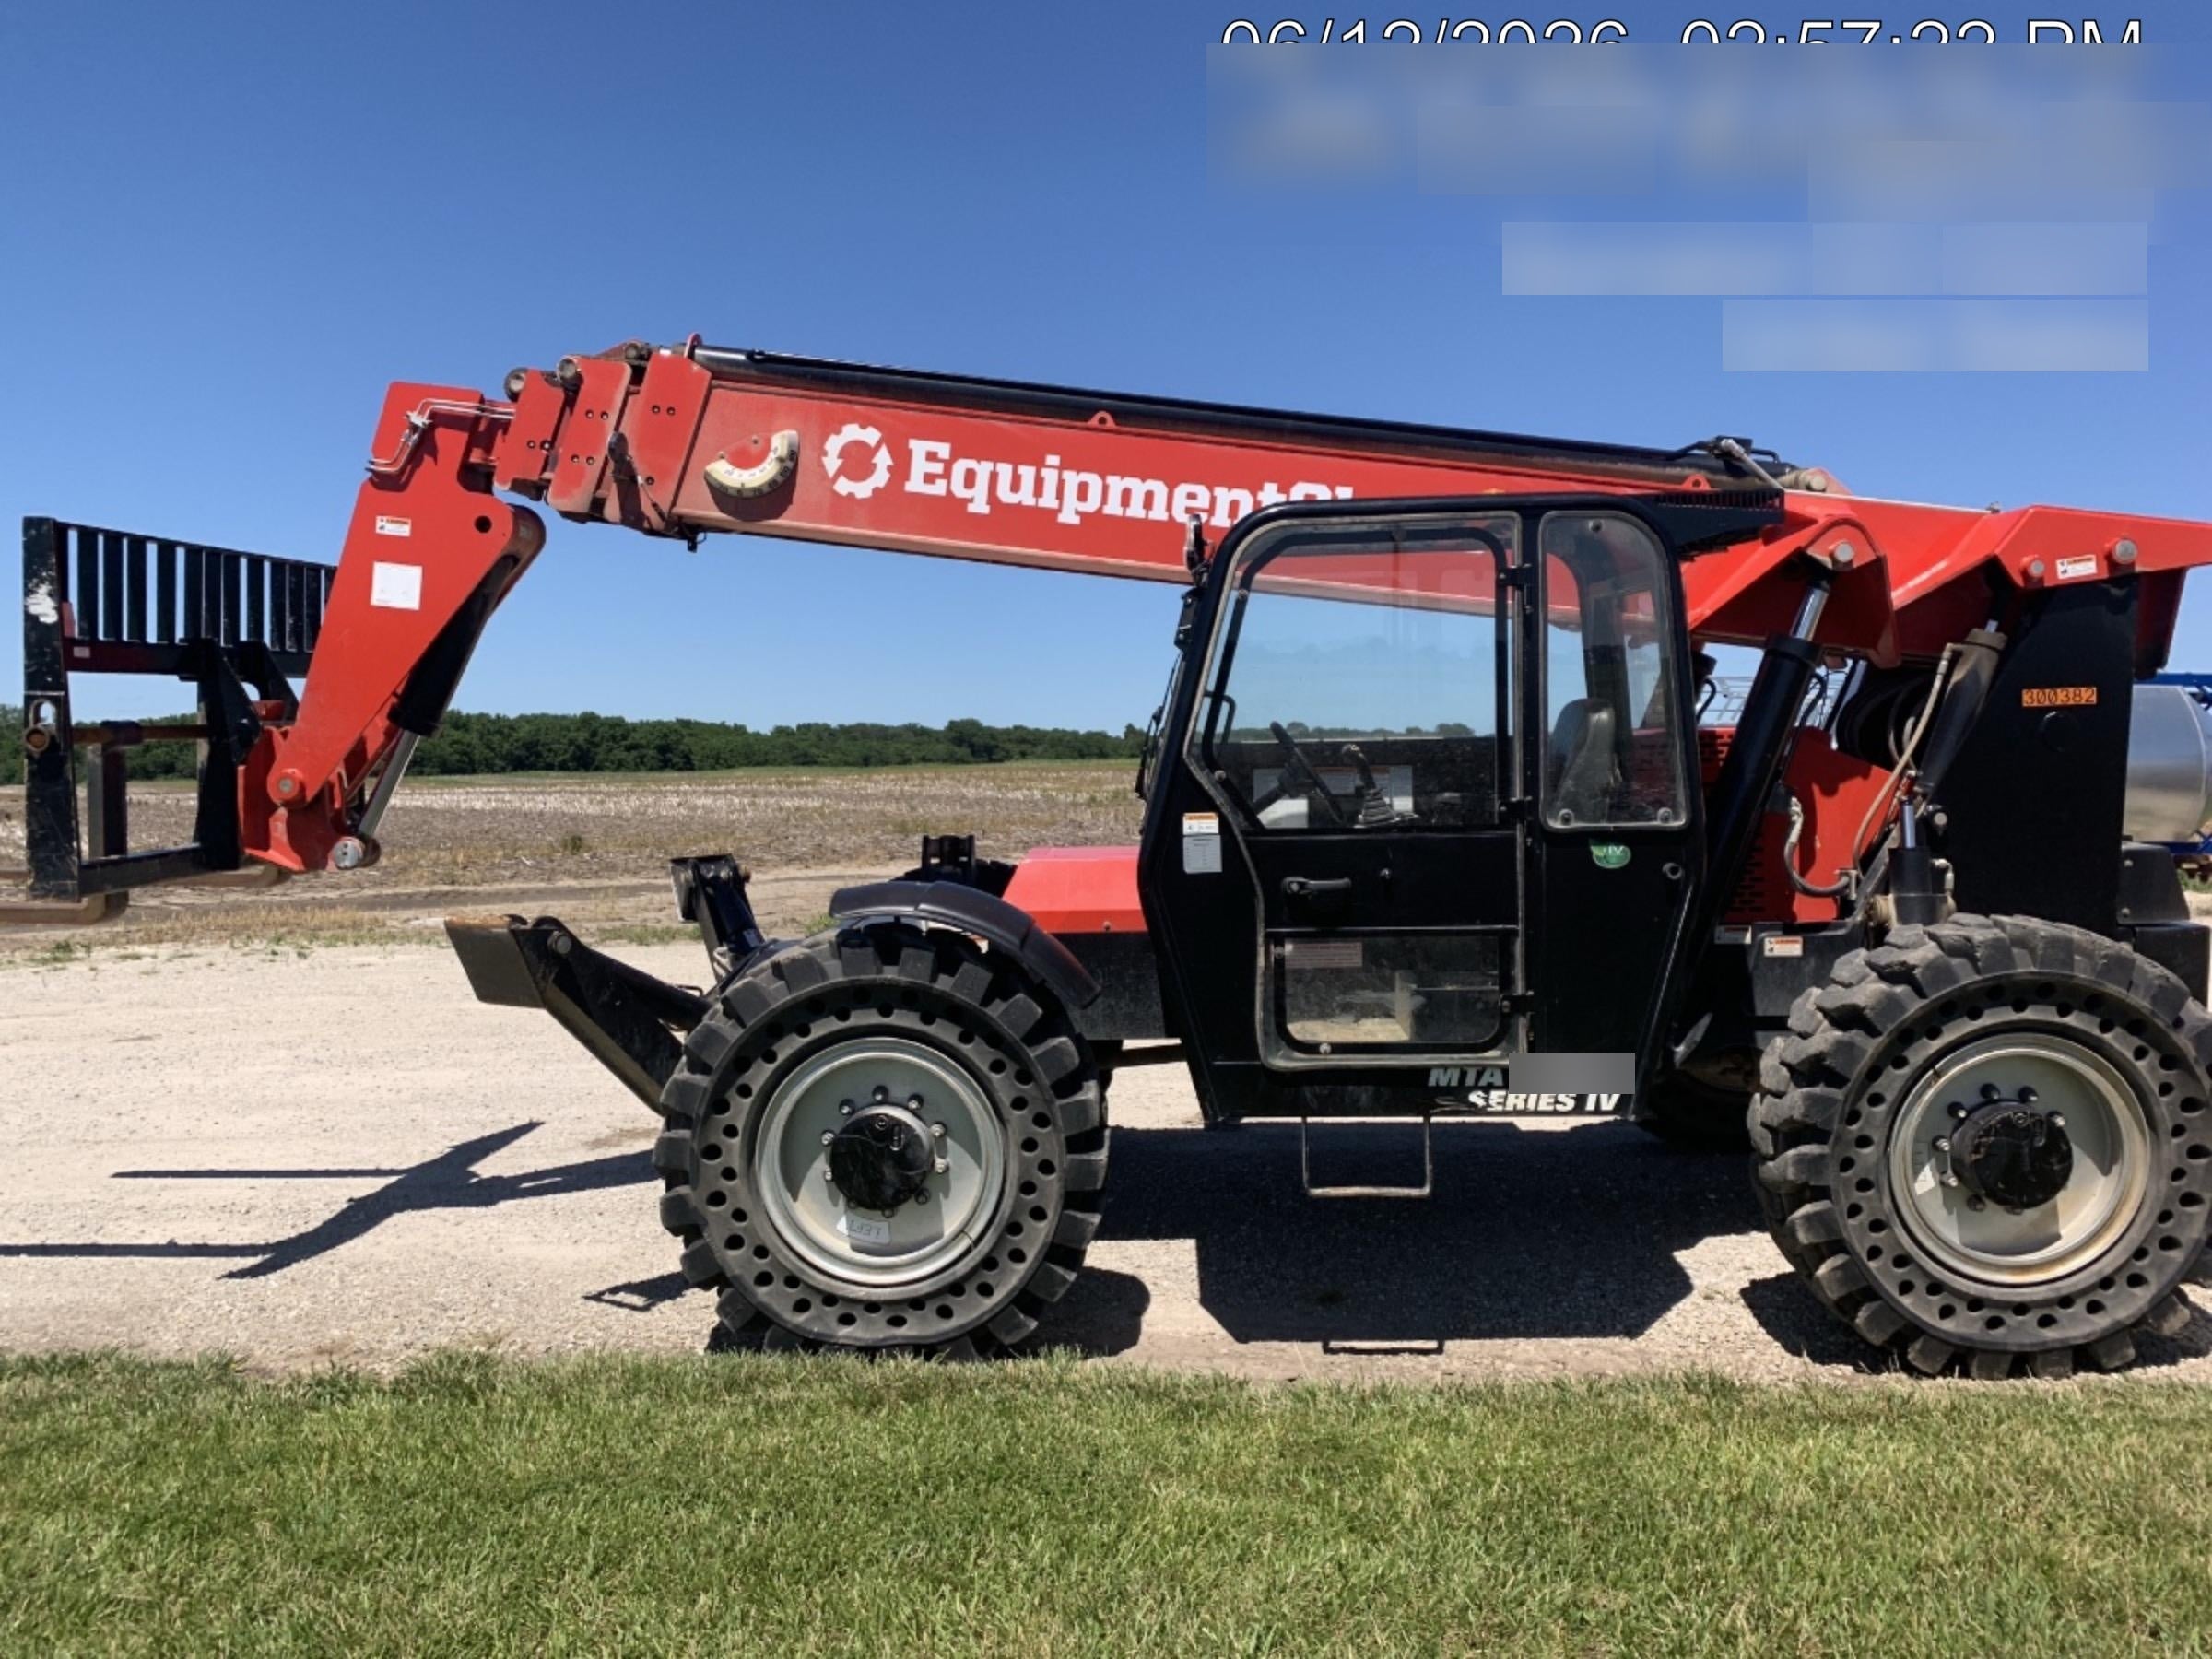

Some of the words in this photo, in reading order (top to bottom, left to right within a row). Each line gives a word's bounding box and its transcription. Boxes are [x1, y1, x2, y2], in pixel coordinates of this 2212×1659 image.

[2024, 688, 2095, 705] 300382
[1429, 1067, 1503, 1087] MTA
[1585, 1094, 1620, 1111] IV
